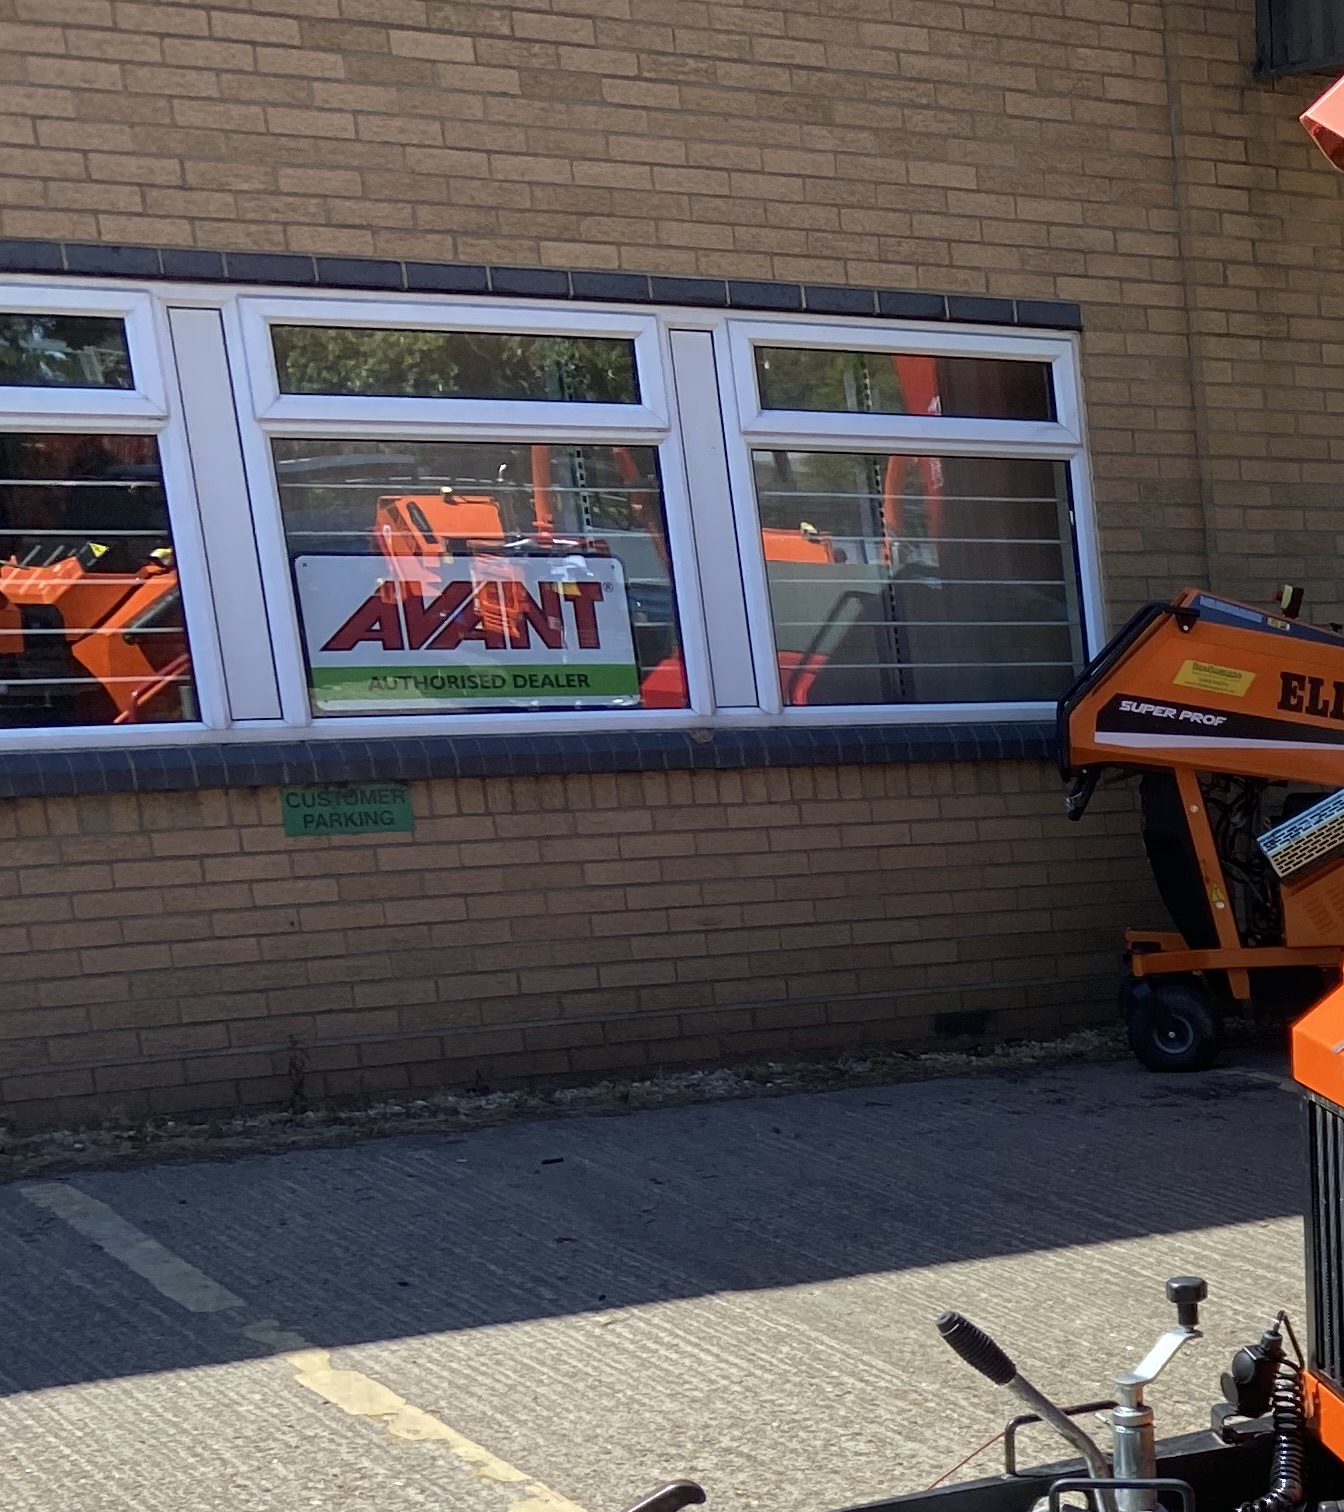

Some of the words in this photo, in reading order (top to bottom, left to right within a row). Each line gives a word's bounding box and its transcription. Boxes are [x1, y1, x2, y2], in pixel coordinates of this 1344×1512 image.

[319, 580, 605, 651] AVANT
[367, 672, 507, 691] AUTHORISED
[512, 672, 591, 689] DEALER
[1118, 700, 1177, 719] SUPER
[1178, 710, 1228, 727] PROF
[285, 788, 407, 809] CUSTOMER
[303, 809, 396, 829] PARKING
